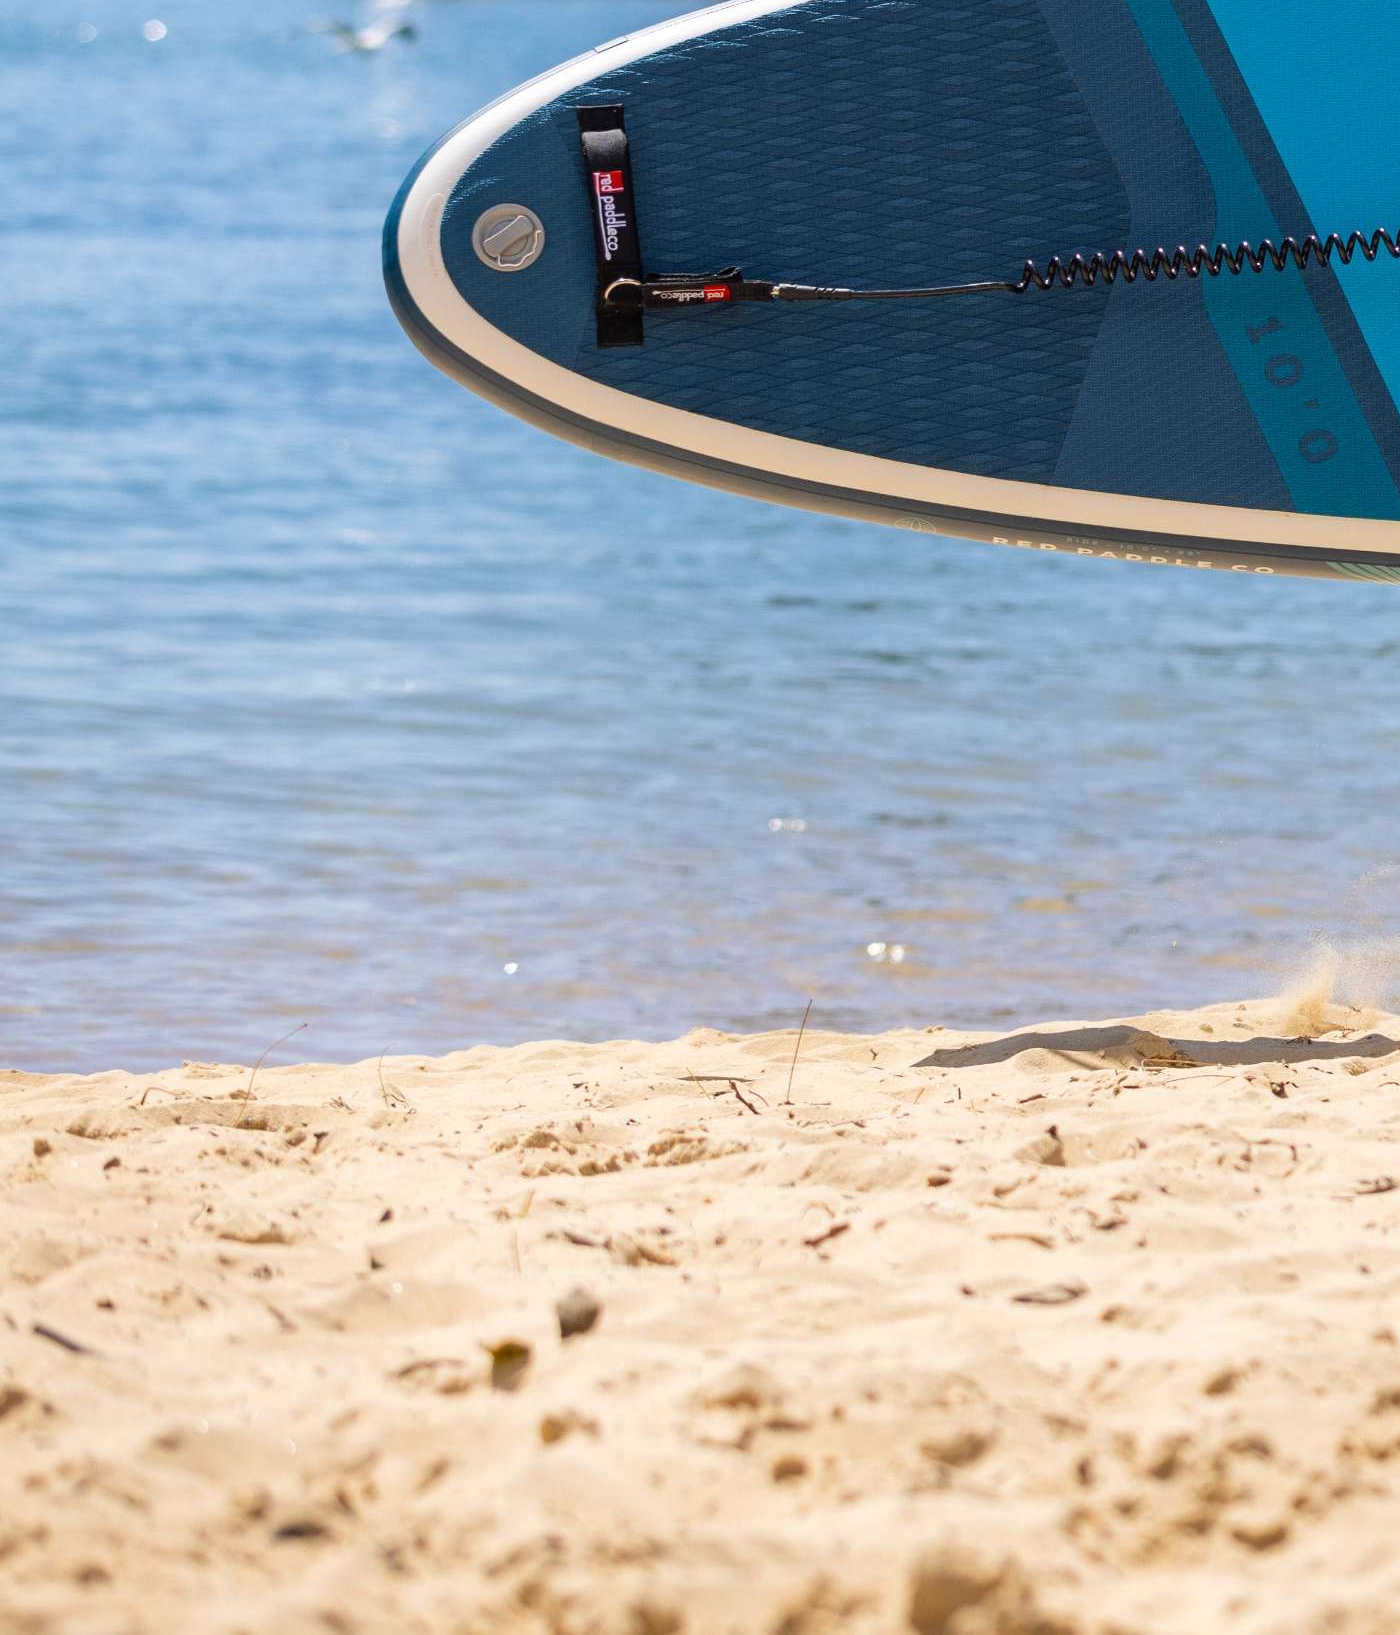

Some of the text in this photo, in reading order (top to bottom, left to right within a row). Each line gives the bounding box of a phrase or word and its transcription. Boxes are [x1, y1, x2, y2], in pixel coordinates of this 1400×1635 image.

[600, 173, 625, 192] red
[992, 536, 1057, 551] RED
[1077, 547, 1213, 569] PADDLE
[1231, 564, 1275, 574] CO
